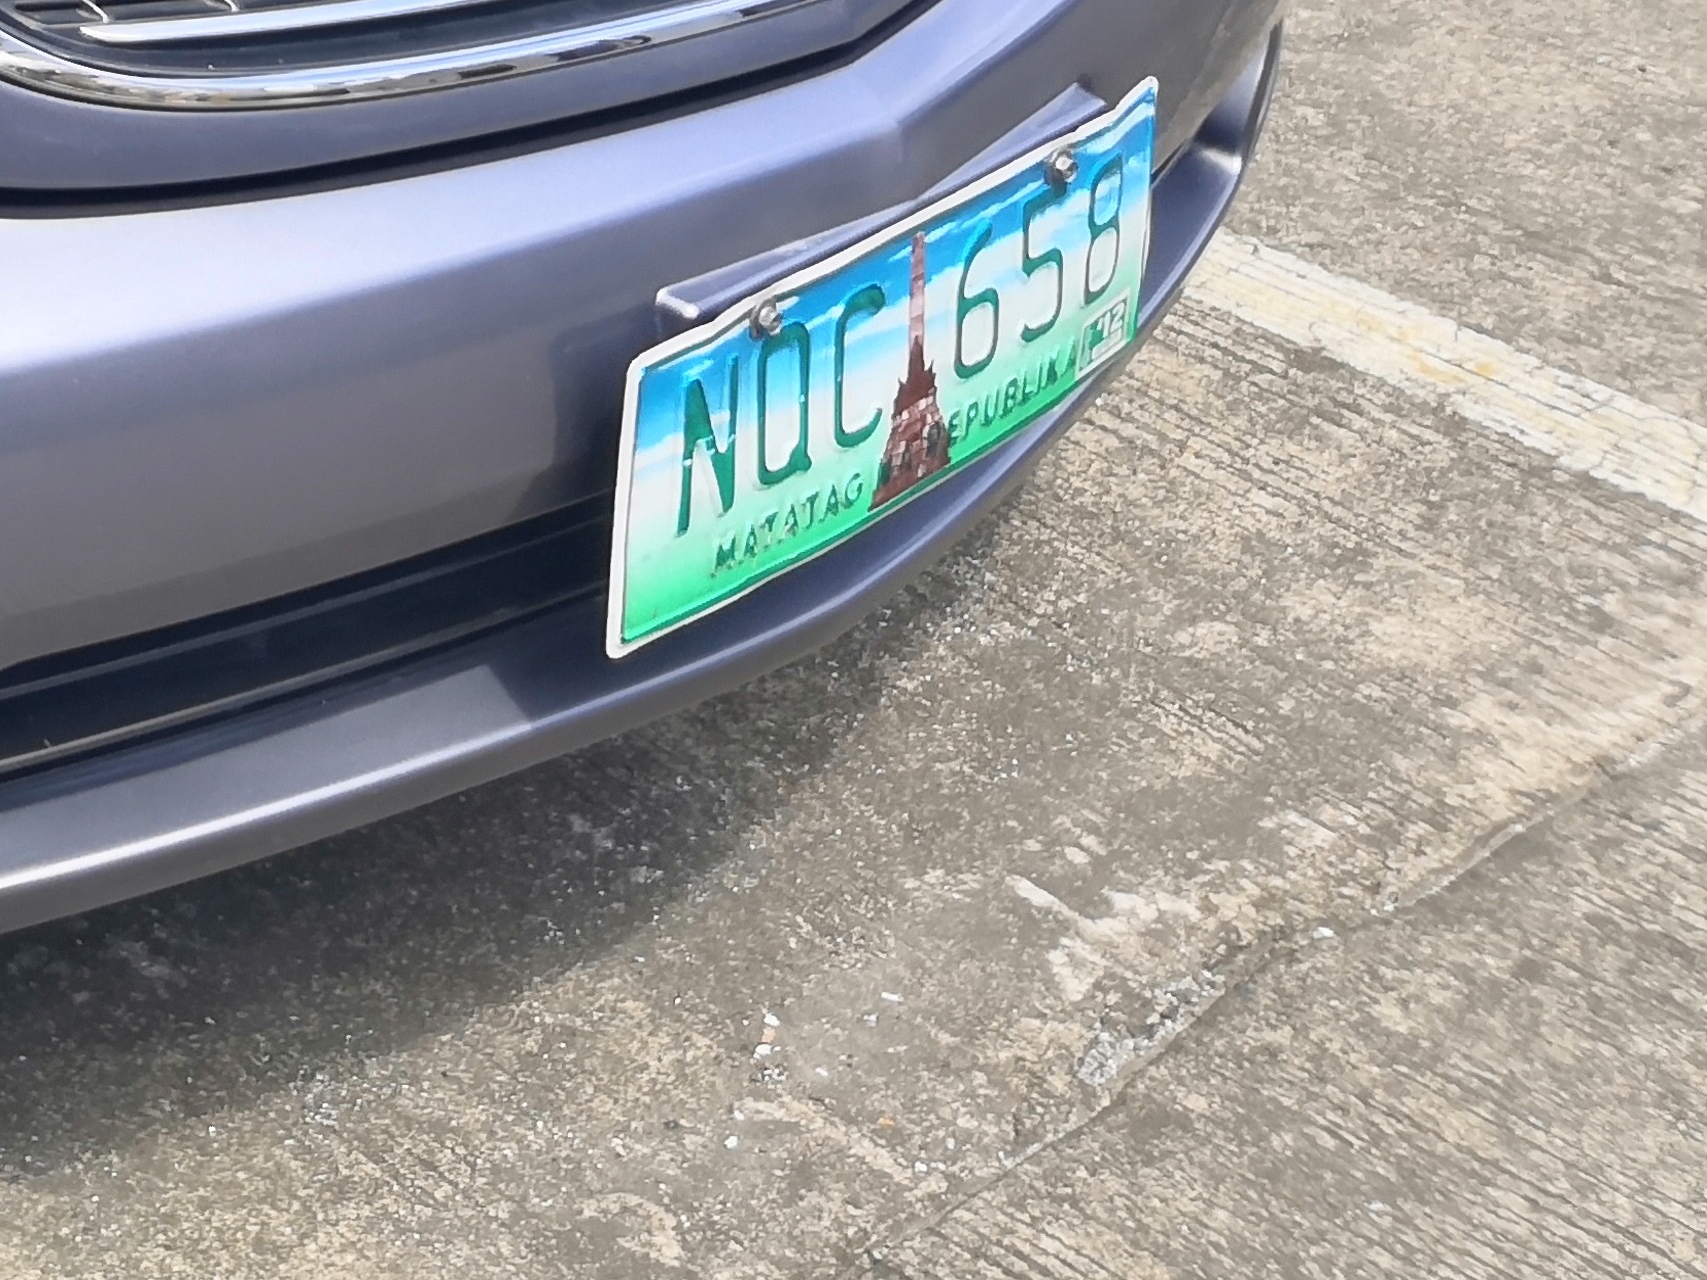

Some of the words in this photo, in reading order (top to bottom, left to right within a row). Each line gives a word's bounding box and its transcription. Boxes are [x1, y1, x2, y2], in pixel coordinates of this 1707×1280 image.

[677, 283, 886, 537] NQC
[953, 151, 1124, 379] 658
[710, 472, 864, 579] MATATAG
